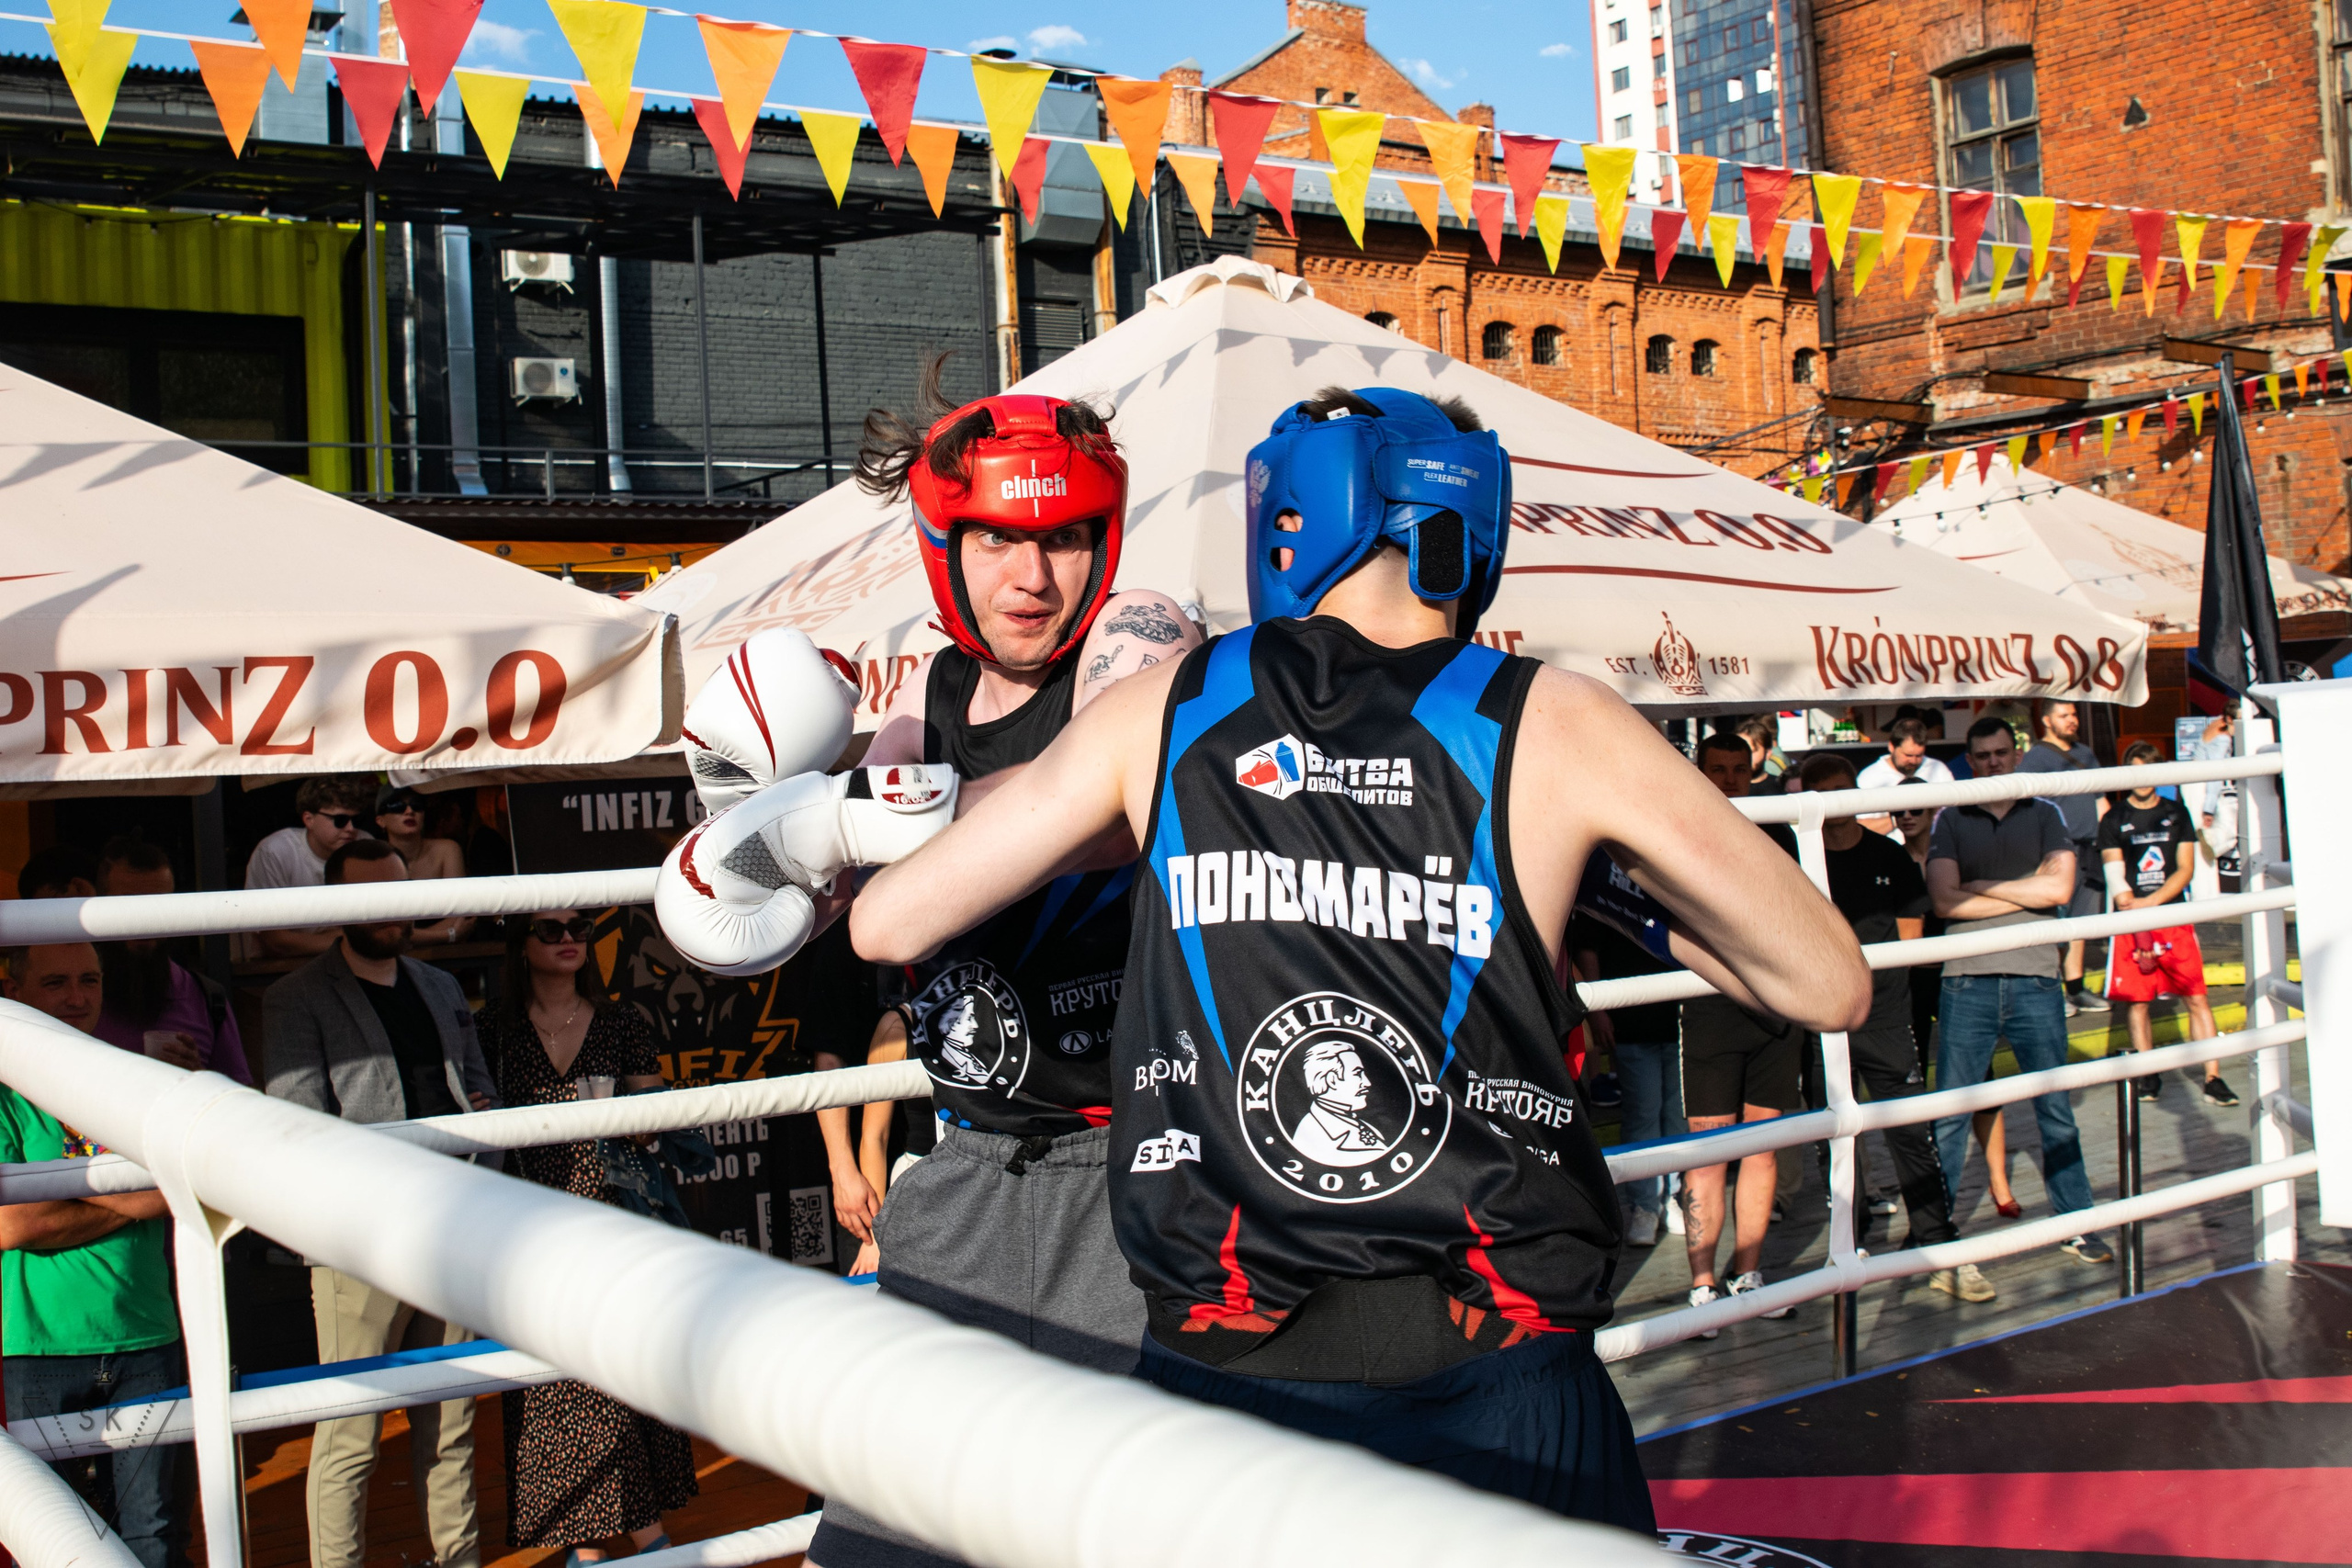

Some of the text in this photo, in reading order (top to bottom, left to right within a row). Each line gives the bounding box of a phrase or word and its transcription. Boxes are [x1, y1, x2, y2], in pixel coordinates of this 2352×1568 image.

[1510, 501, 1833, 555] PRINZ 0.0
[1605, 656, 1750, 676] EST. 1581
[364, 649, 568, 755] 0.0
[1305, 742, 1414, 788] БИТВА
[1167, 850, 1493, 960] ПОНОМАРЁВ
[1049, 978, 1124, 1017] КРУТО
[1487, 1077, 1520, 1089] РУССКАЯ
[1282, 1152, 1414, 1192] 2010
